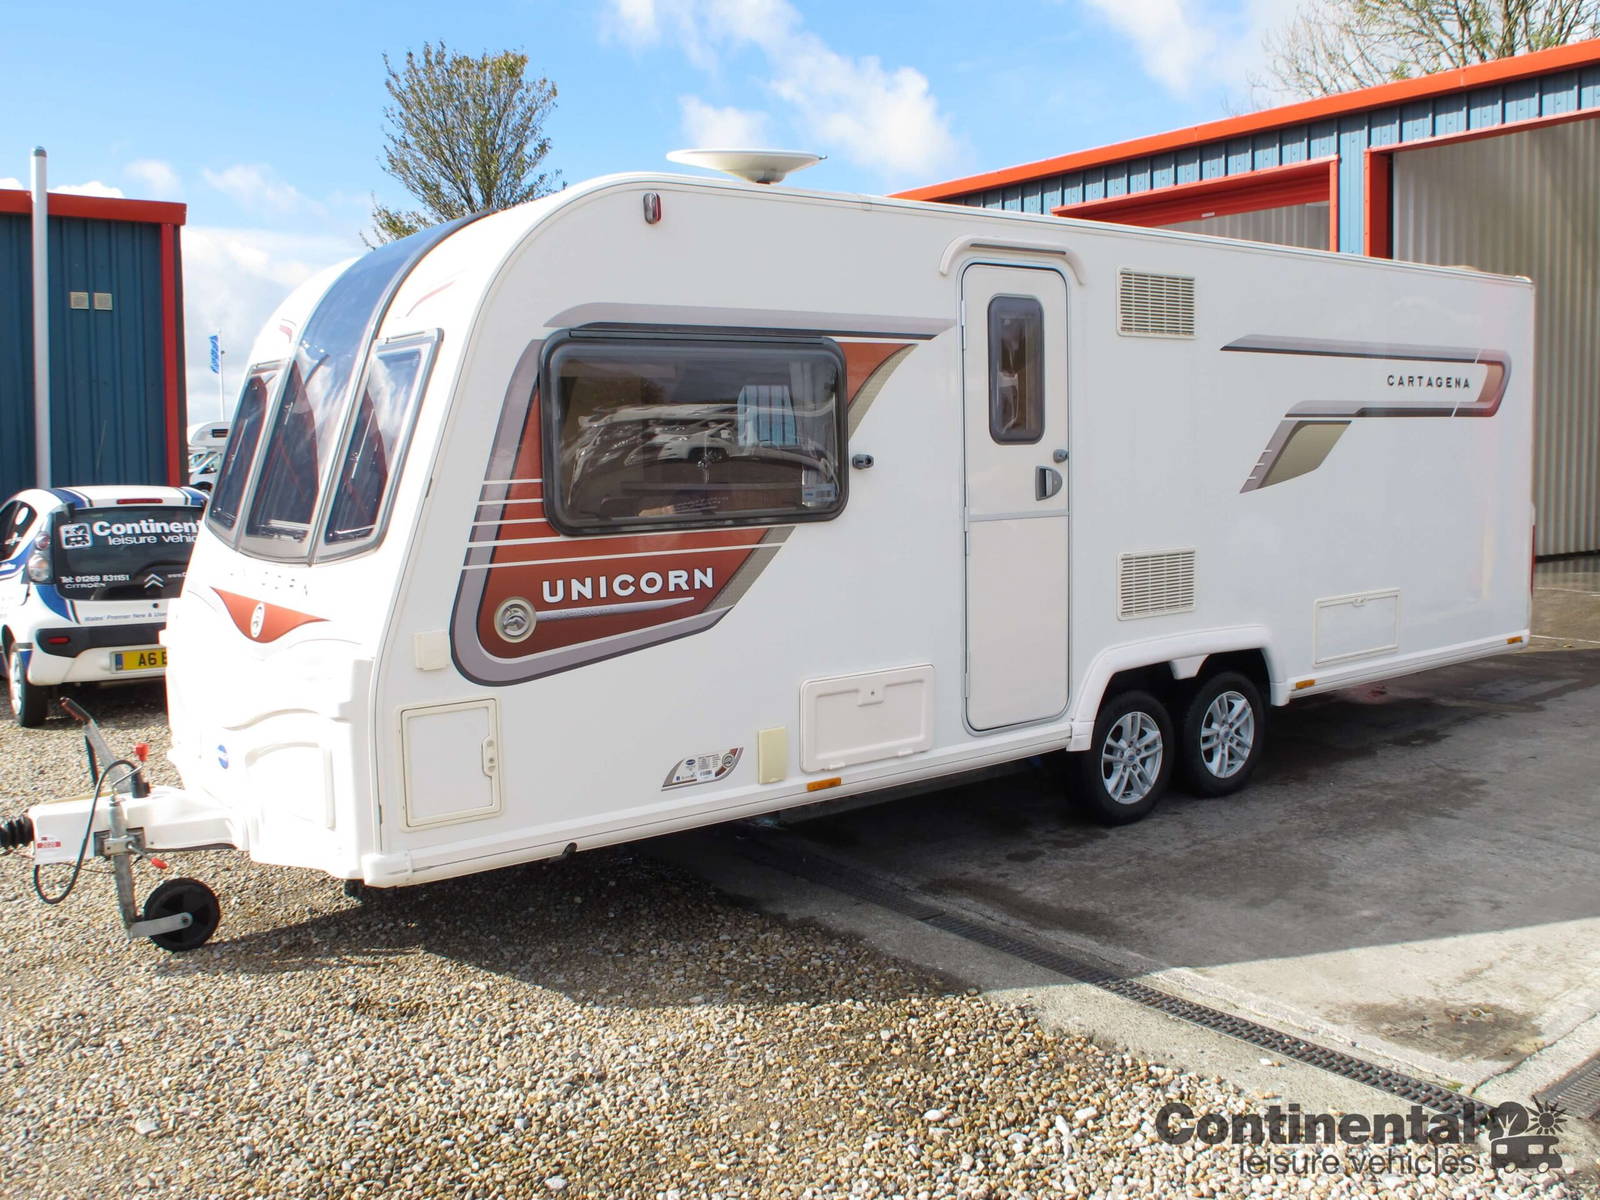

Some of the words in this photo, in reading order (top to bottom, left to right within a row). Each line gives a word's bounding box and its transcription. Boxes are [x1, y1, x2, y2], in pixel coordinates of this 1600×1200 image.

[1386, 374, 1471, 389] CARTAGENA
[107, 534, 157, 546] leisure
[541, 566, 714, 604] UNICORN
[138, 652, 158, 667] A6
